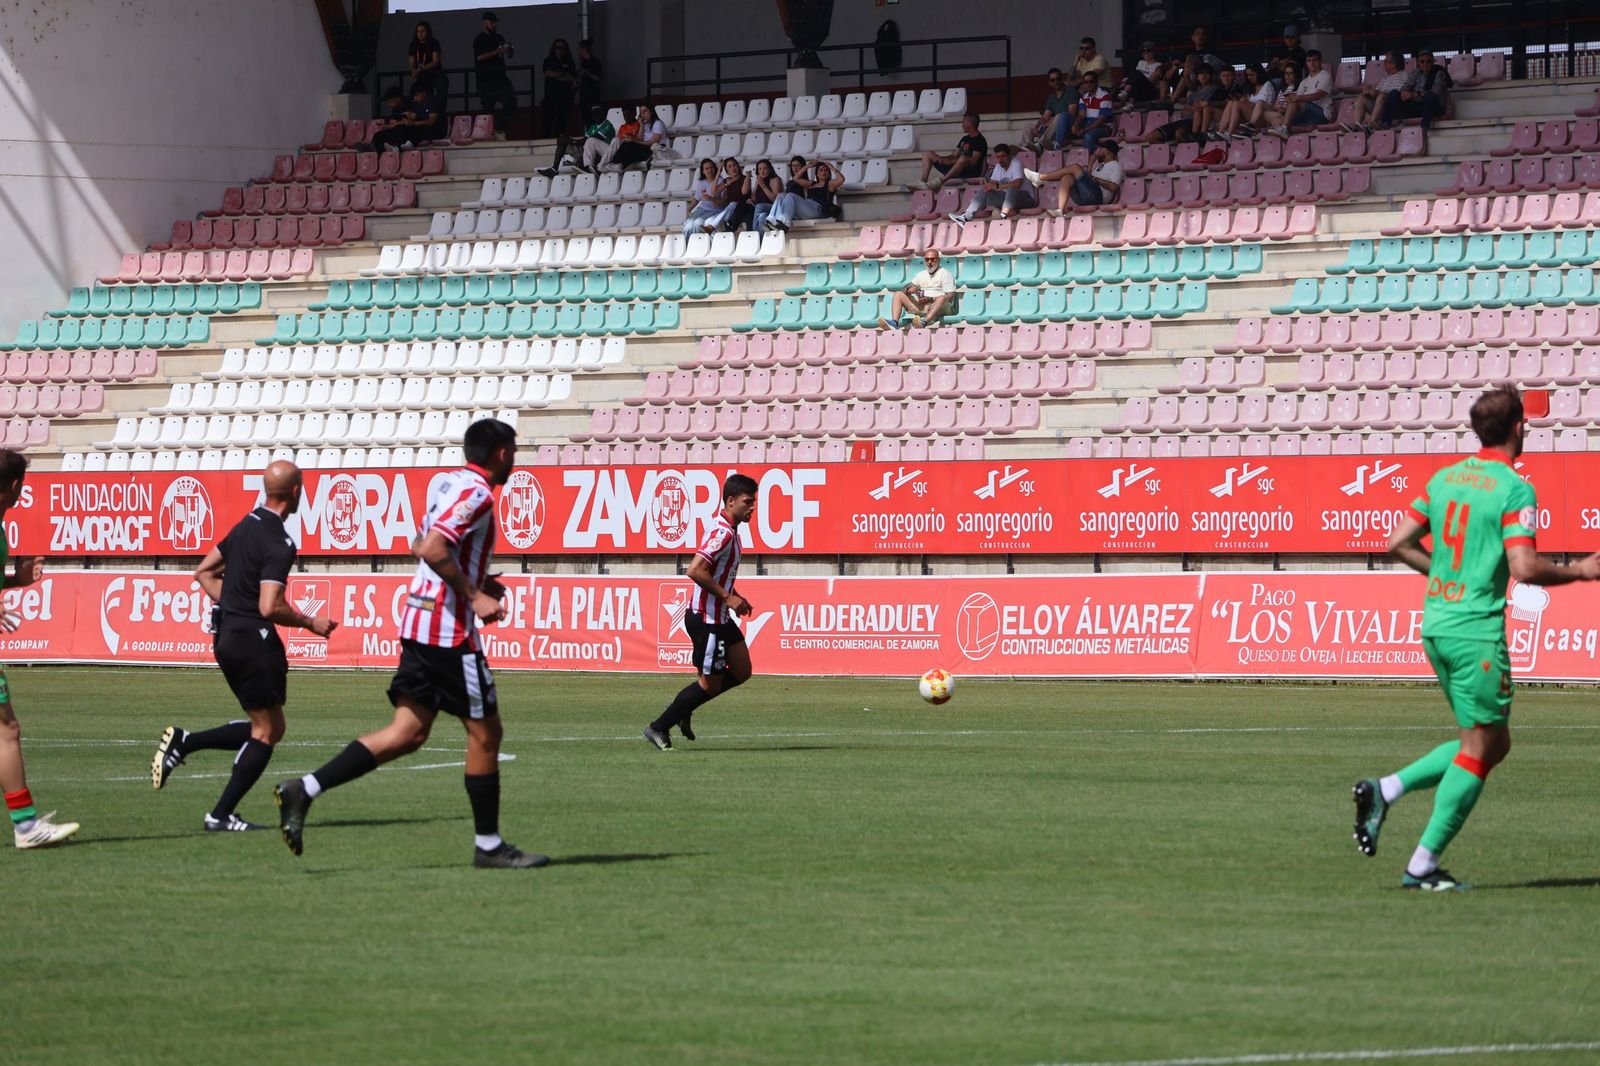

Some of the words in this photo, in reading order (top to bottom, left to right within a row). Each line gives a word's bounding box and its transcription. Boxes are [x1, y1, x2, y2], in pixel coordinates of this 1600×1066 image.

[50, 477, 152, 512] FUNDACIÓN
[912, 481, 928, 497] sgc
[1019, 480, 1035, 496] sgc
[1144, 478, 1161, 495] sgc
[1257, 477, 1275, 495] sgc
[1390, 476, 1408, 492] sgc
[852, 507, 945, 540] sangregorio
[956, 506, 1053, 539] sangregorio
[1079, 505, 1179, 538] sangregorio
[1191, 504, 1294, 538] sangregorio
[1321, 509, 1408, 537] sangrego
[50, 516, 152, 551] ZAMORACF
[1442, 499, 1470, 571] 4
[343, 584, 383, 628] E.S.
[534, 587, 562, 629] LA
[571, 587, 643, 630] PLATA
[780, 604, 939, 632] VALDERADUEY
[1002, 604, 1070, 635] ELOY
[1075, 597, 1194, 635] ÁLVAREZ
[1305, 601, 1425, 644] VIVALE
[8, 640, 49, 650] COMPANY
[122, 642, 130, 652] A
[132, 641, 174, 652] GOODLIFE
[177, 643, 205, 653] FOODS
[288, 641, 327, 658] RepoSTAR
[481, 635, 520, 658] Vino
[529, 635, 622, 662] (Zamora)
[718, 641, 725, 657] 5
[781, 639, 790, 649] EL
[793, 640, 829, 649] CENTRO
[832, 640, 884, 650] COMERCIAL
[887, 640, 898, 650] DE
[901, 640, 939, 650] ZAMORA
[1001, 638, 1110, 655] CONTRUCCIONES
[1114, 634, 1189, 654] METÁLICAS
[1282, 649, 1296, 662] DE
[1346, 650, 1383, 663] LECHE
[1385, 650, 1427, 664] CRUDA
[658, 650, 693, 665] RepoSTA
